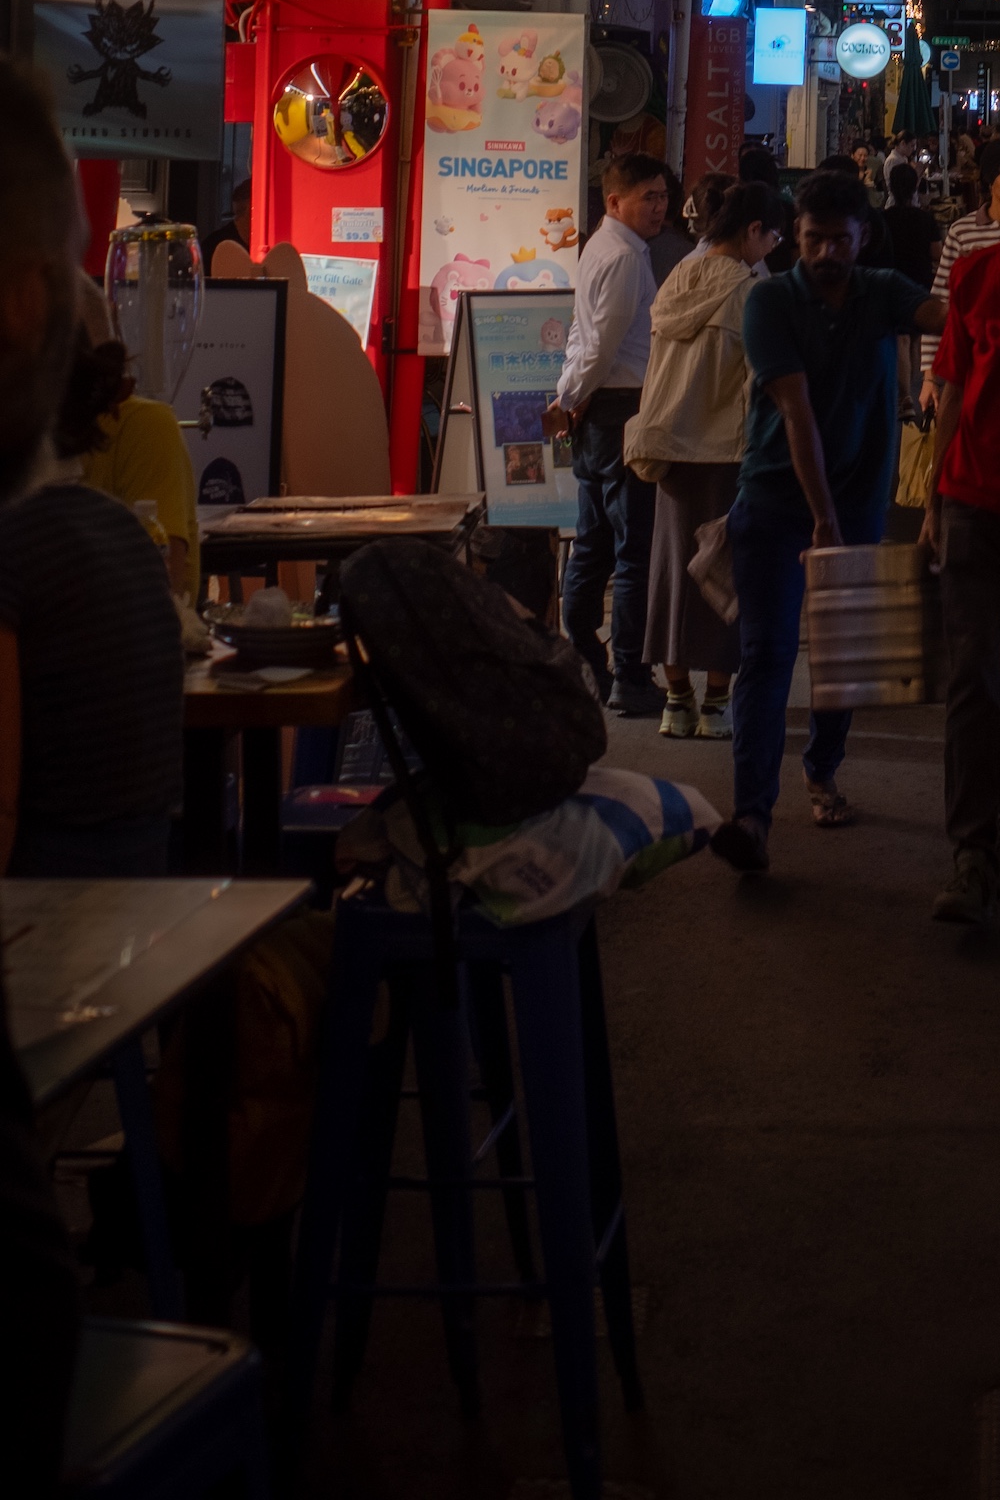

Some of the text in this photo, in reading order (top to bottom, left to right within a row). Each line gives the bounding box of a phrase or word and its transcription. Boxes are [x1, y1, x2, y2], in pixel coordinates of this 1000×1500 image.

[707, 28, 741, 43] 16B
[120, 128, 192, 138] STUDIOS
[438, 157, 569, 180] SINGAPORE
[346, 232, 369, 240] $9.9
[324, 274, 340, 284] Gift
[343, 275, 363, 286] Gate
